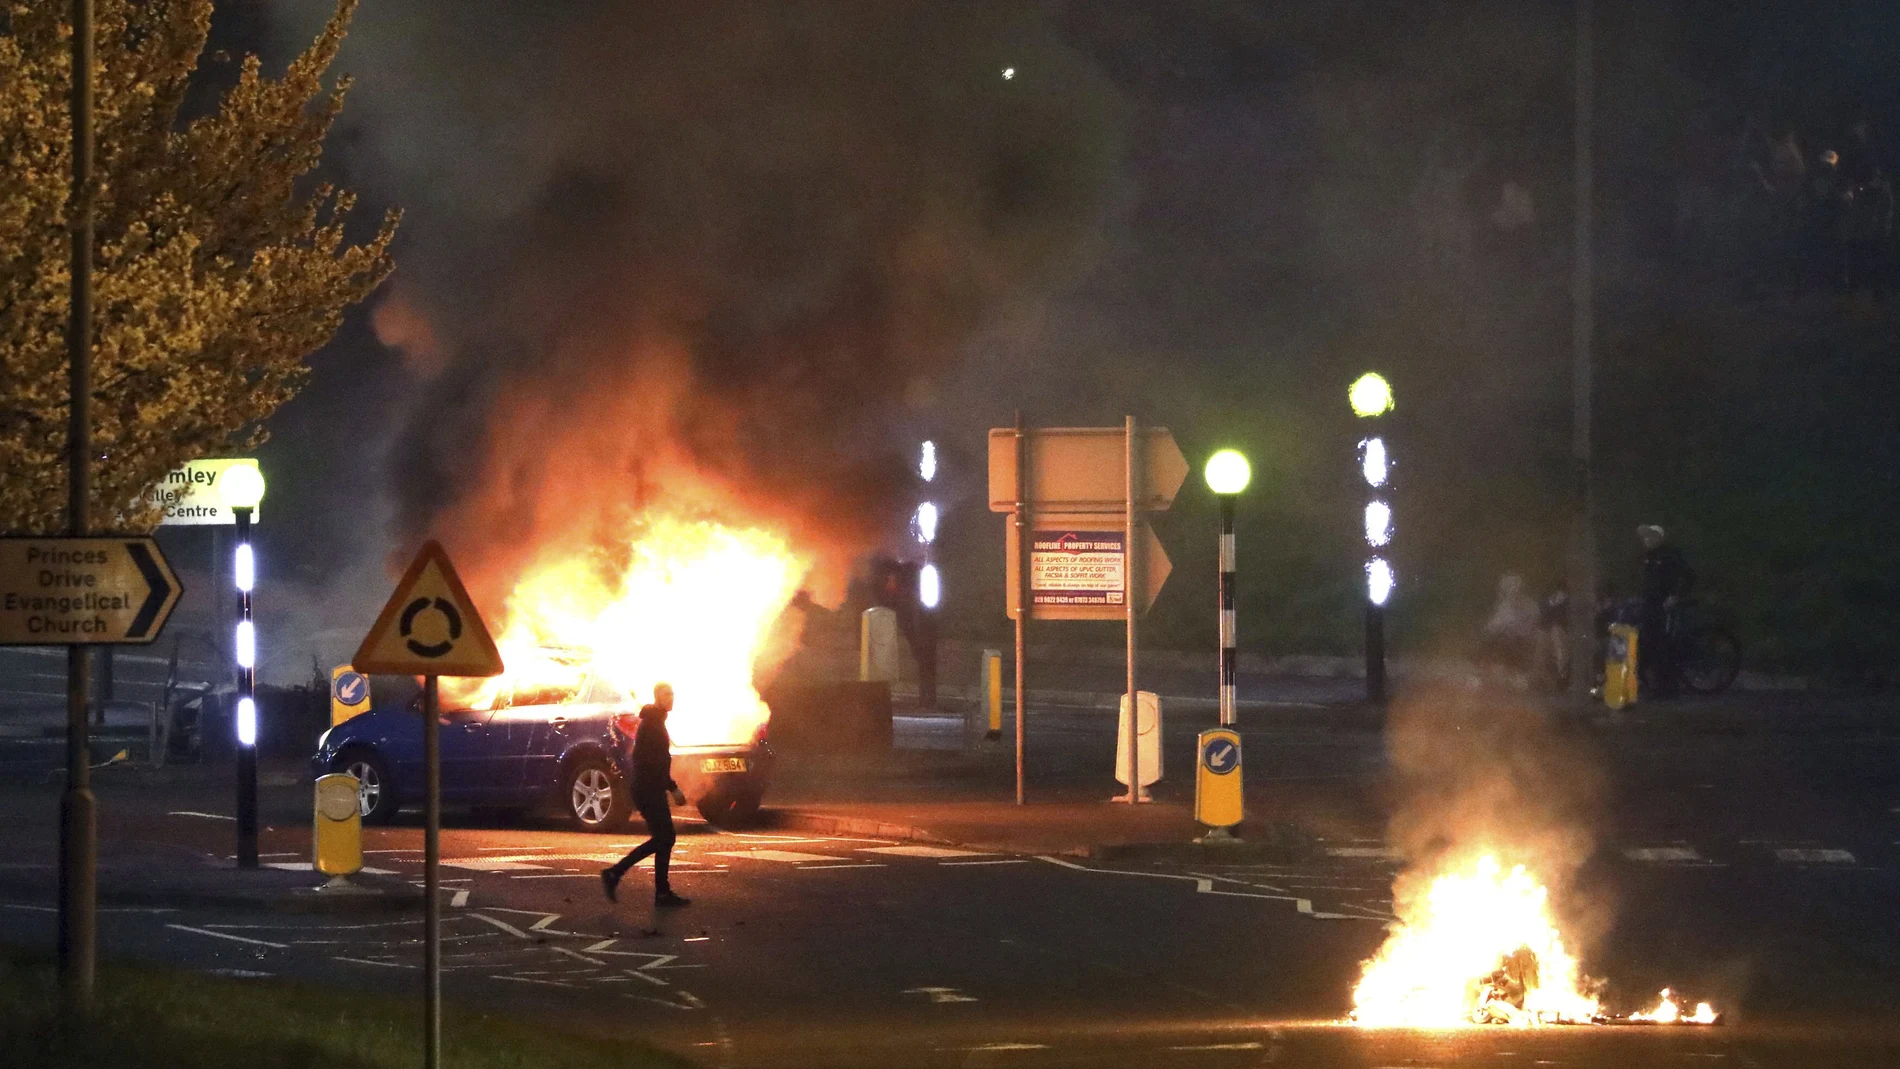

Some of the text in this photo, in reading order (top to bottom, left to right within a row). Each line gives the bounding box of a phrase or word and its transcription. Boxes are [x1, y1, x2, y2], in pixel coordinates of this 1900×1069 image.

[166, 505, 218, 518] Centre
[1034, 542, 1121, 550] ROOFLINE PROPERTY SERVICES
[26, 547, 108, 565] Princes
[39, 571, 97, 588] Drive
[3, 593, 130, 612] Evangelical
[28, 615, 107, 634] Church
